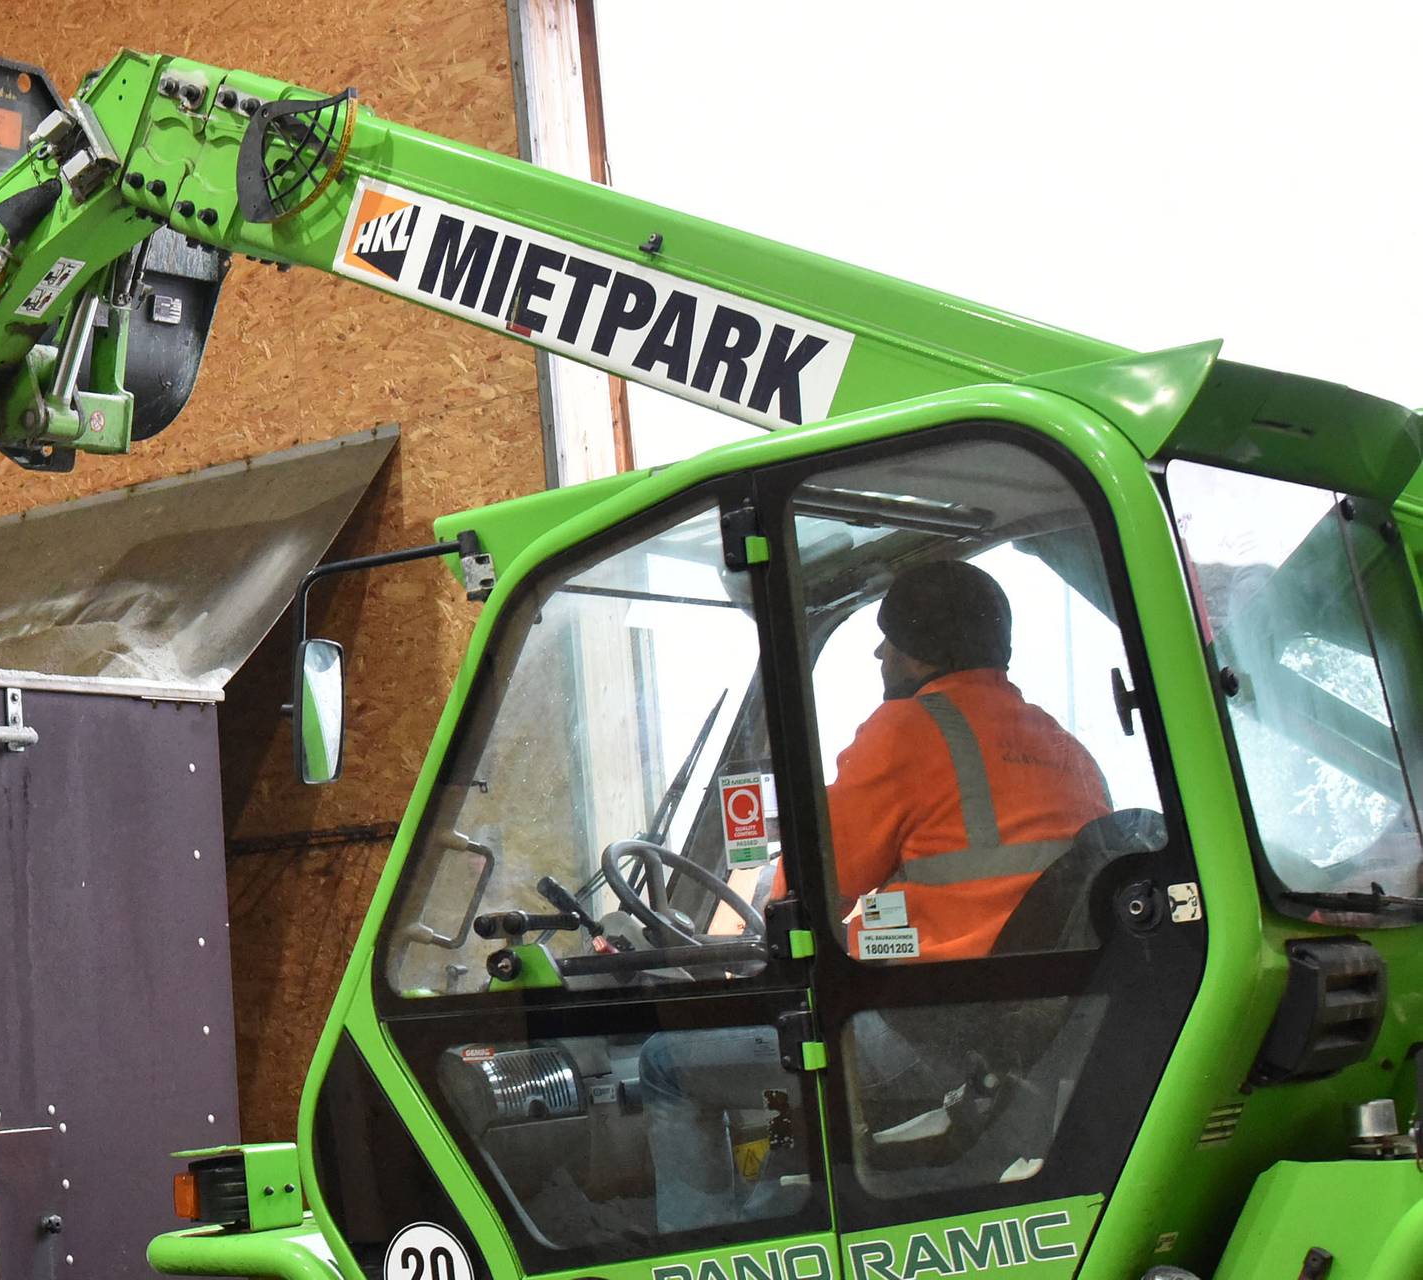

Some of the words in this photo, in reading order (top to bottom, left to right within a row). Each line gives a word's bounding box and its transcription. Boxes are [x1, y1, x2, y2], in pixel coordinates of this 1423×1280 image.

[352, 205, 411, 254] HKL
[418, 214, 829, 425] MIETPARK
[727, 788, 760, 825] Q
[734, 830, 758, 838] CONTROL
[735, 824, 757, 832] QUALITY
[865, 942, 915, 955] 18001202
[401, 1246, 457, 1280] 20
